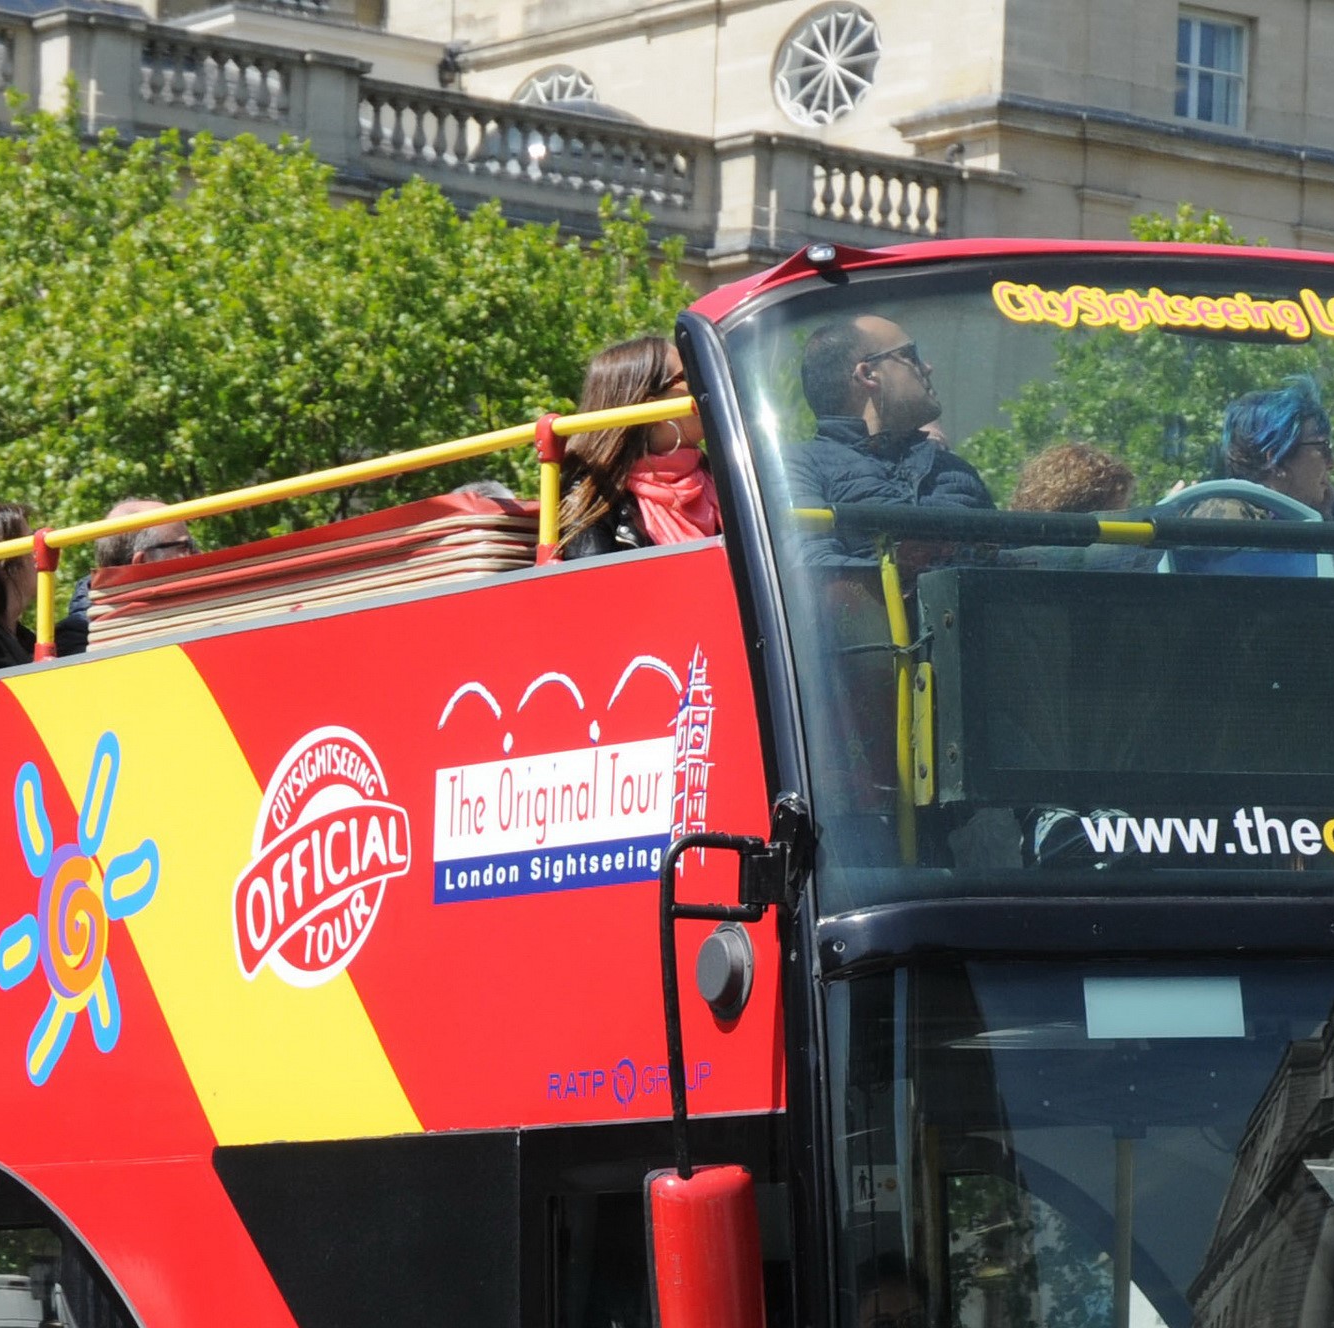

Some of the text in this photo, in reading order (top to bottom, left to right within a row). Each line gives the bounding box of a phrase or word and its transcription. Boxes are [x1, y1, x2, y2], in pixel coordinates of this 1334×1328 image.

[272, 744, 377, 830] CITYSIGHTSEEING
[449, 750, 663, 845] The Original Tour
[246, 816, 407, 950] OFFICIAL
[445, 846, 662, 890] London Sightseeing
[304, 889, 371, 963] TOUR
[548, 1062, 712, 1099] RATP GRUP
